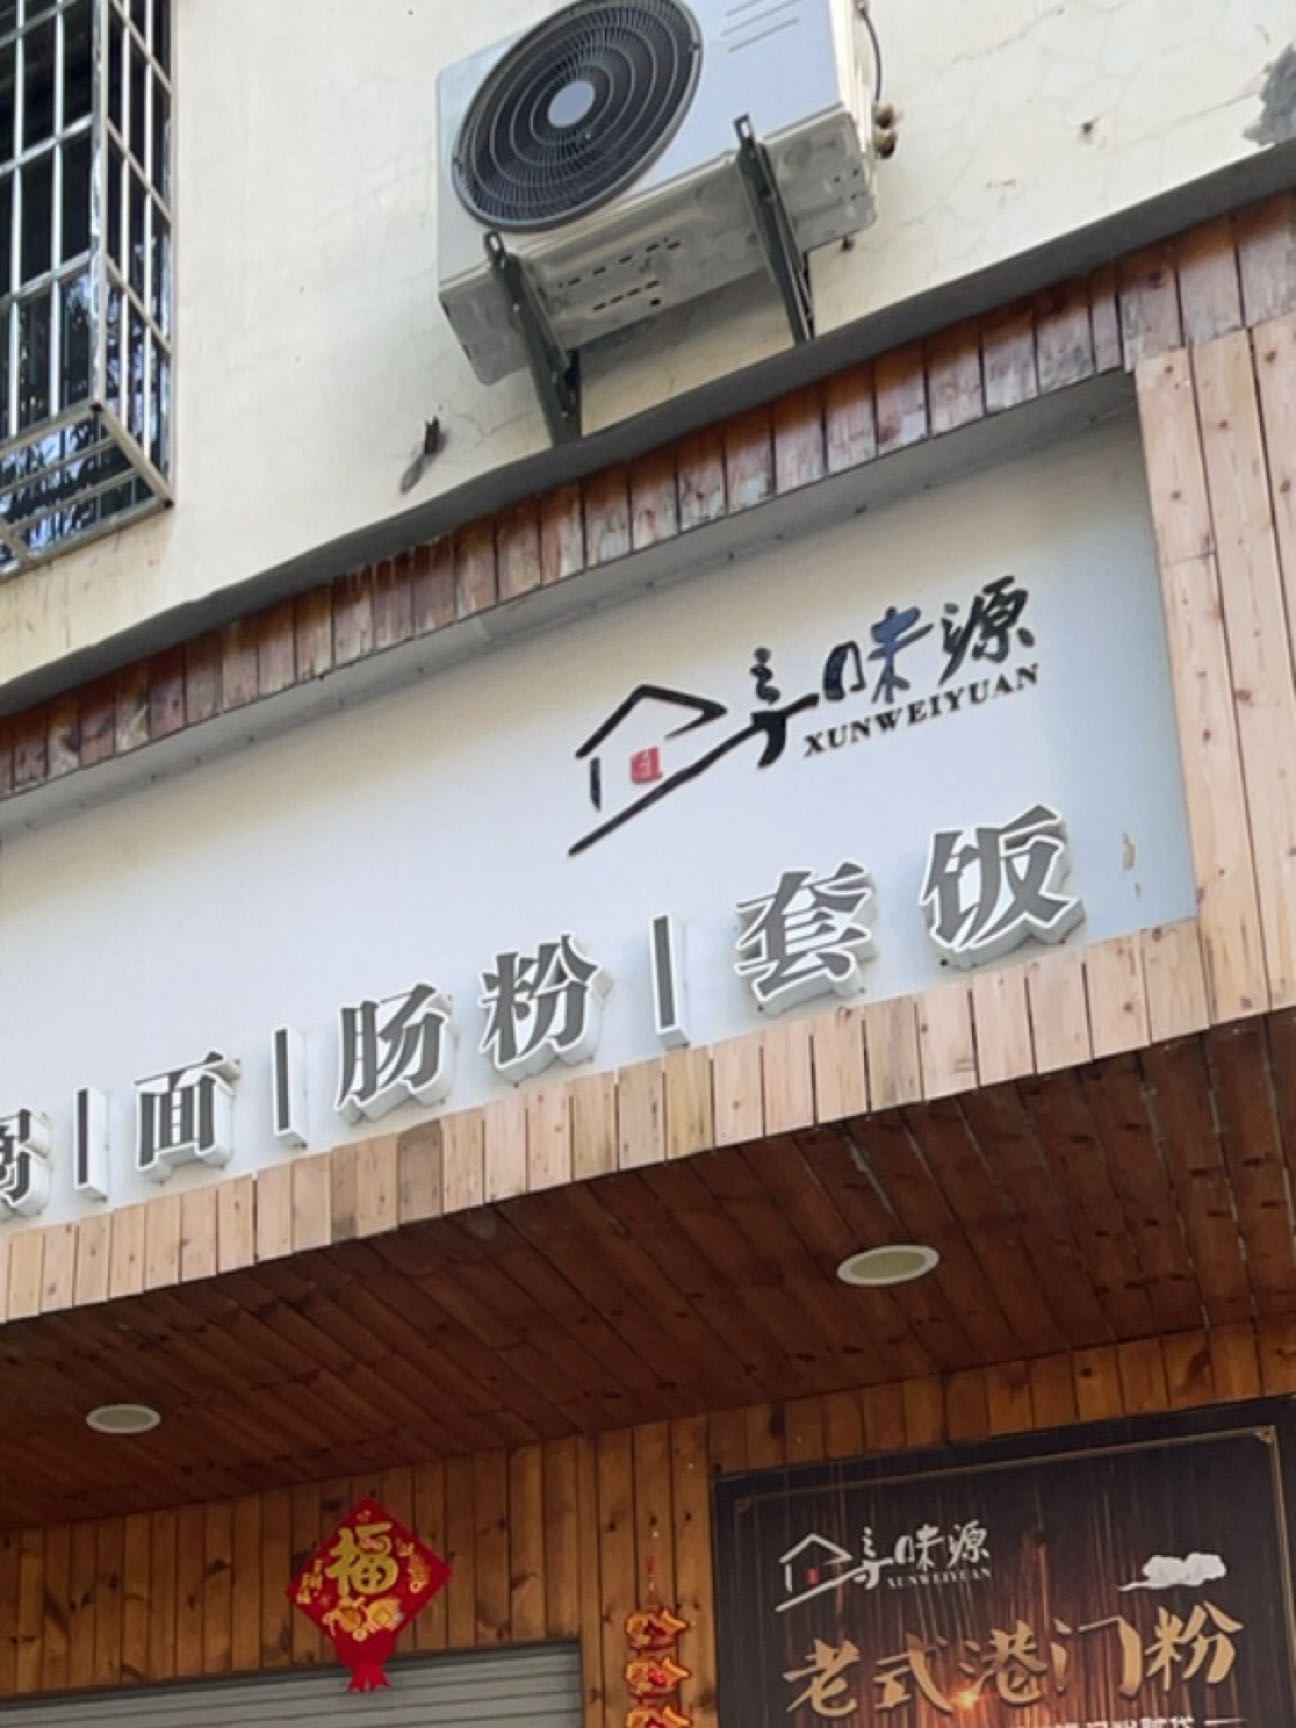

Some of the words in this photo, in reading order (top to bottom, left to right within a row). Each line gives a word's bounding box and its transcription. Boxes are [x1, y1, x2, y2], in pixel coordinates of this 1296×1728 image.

[804, 663, 1040, 758] XUNWEIYUAN
[325, 1522, 400, 1607] 福
[783, 1602, 1244, 1717] 老式港门粉
